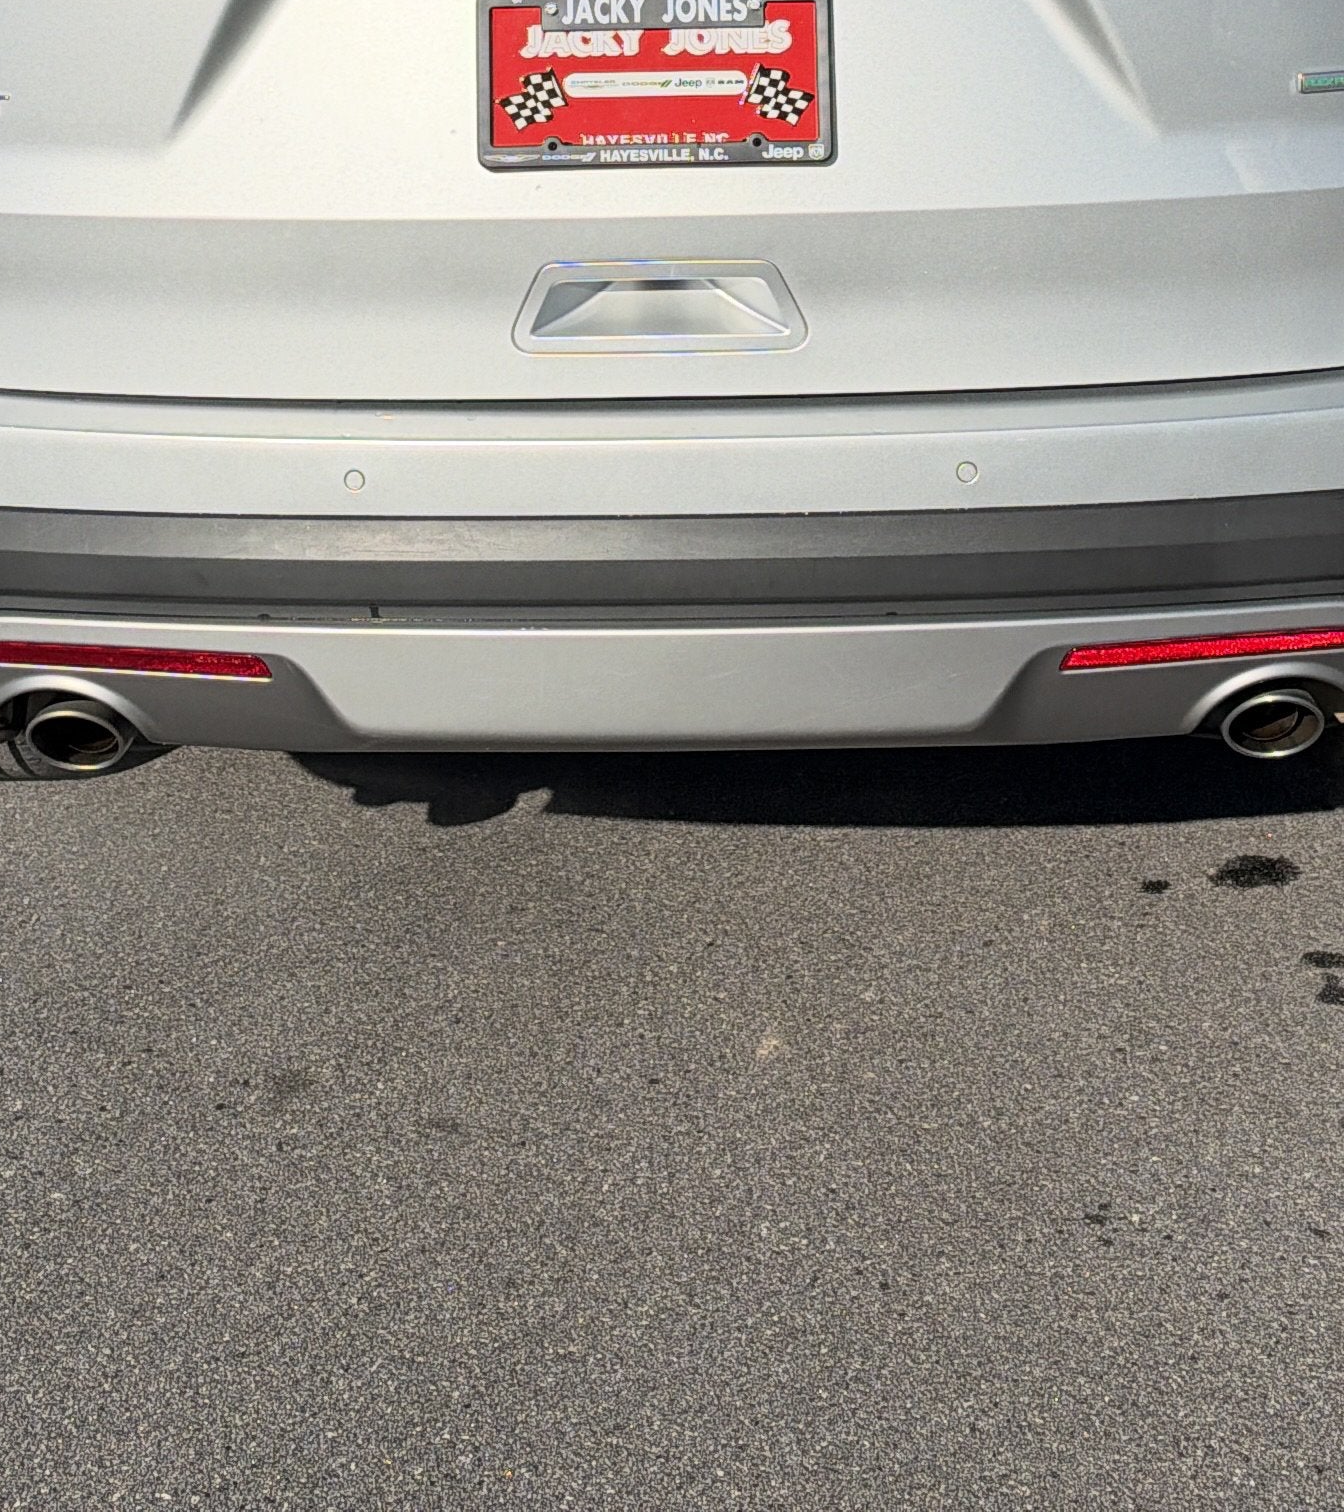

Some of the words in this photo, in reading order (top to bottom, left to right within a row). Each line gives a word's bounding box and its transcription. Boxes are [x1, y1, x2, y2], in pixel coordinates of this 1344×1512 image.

[520, 25, 644, 58] JACKY
[661, 19, 793, 56] JONES
[674, 78, 703, 89] Jeep
[599, 148, 695, 163] HAYESVILLE,
[699, 148, 729, 161] N.C.
[762, 144, 804, 160] Jeep
